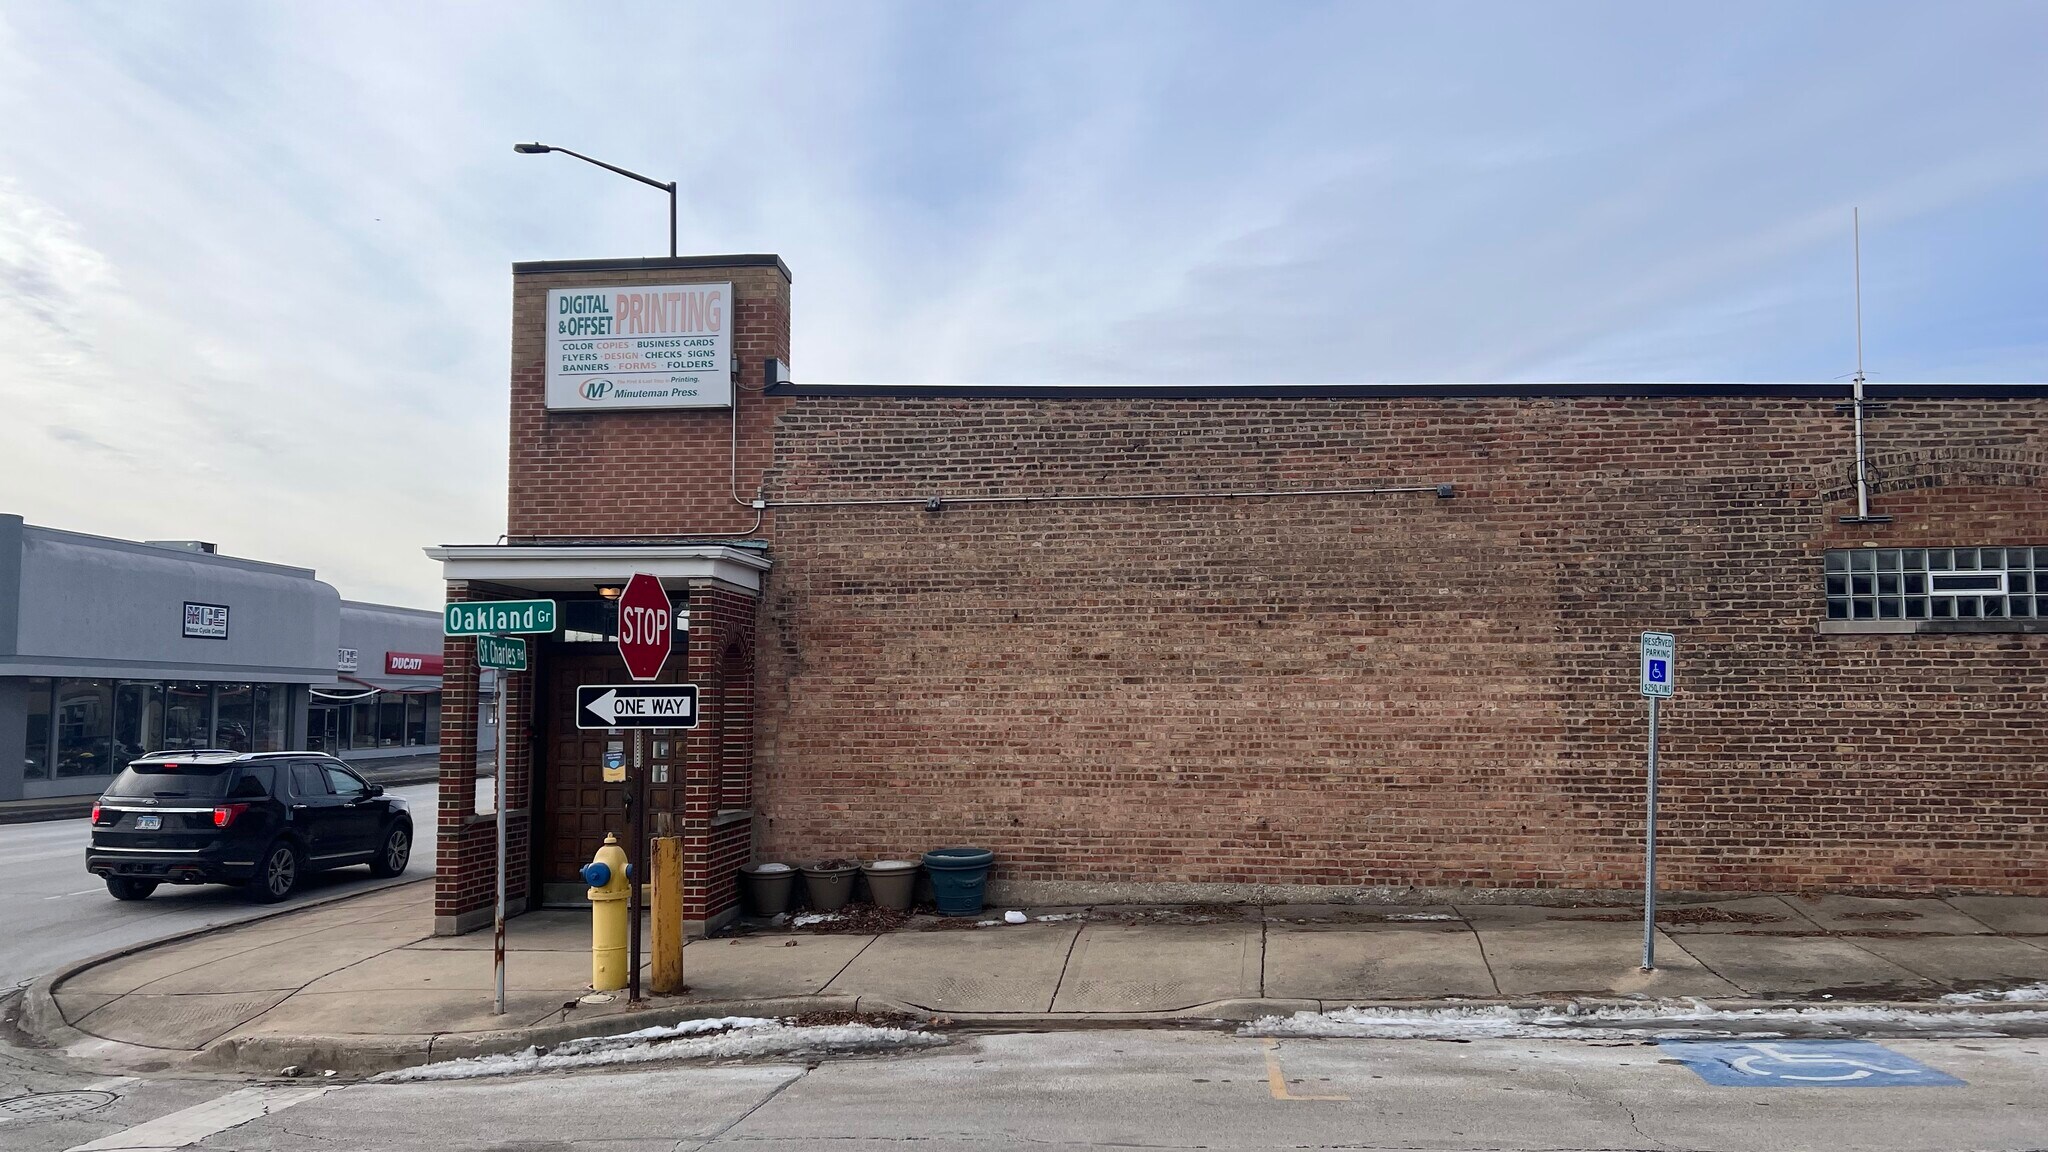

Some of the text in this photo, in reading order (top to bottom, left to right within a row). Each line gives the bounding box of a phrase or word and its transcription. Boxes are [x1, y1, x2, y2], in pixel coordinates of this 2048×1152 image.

[560, 295, 609, 314] DIGITAL
[615, 290, 721, 335] PRINTING
[558, 316, 613, 336] & OFFSET
[562, 339, 715, 351] COLOR COPIES BUSINESS CARDS
[562, 350, 716, 362] FLYERS DESIGN CHECKS SIGNS
[562, 360, 714, 372] BANNERS FORMS FOLDERS
[614, 387, 699, 399] Minuteman Press
[449, 606, 551, 631] Oakland Gr
[622, 606, 668, 646] STOP
[1645, 637, 1672, 647] RESERVED
[480, 638, 489, 663] St
[490, 640, 517, 666] Charles
[1646, 648, 1670, 658] PARKING
[391, 657, 422, 669] DUCATI
[1659, 685, 1670, 693] FINE
[614, 699, 684, 715] ONE WAY
